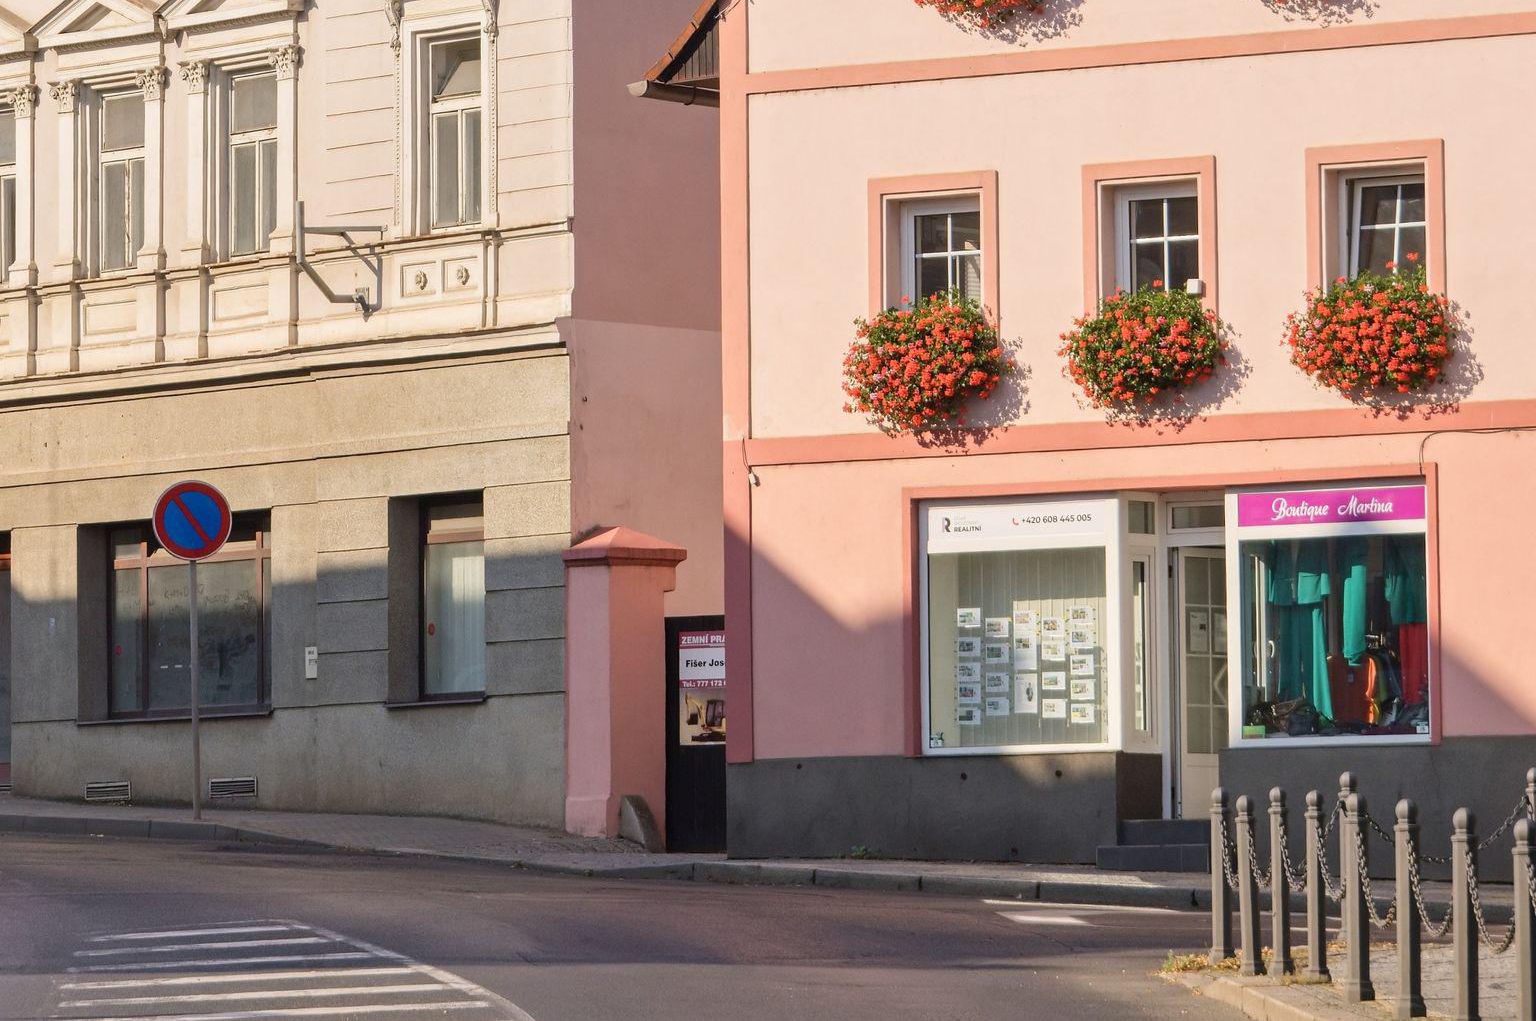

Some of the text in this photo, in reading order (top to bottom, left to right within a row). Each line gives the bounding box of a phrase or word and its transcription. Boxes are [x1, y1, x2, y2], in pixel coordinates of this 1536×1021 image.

[1271, 495, 1393, 521] Boutique Martina
[1022, 513, 1092, 524] +420 608 445 005
[681, 634, 709, 644] ZEMNÍ
[686, 660, 706, 668] Fišer
